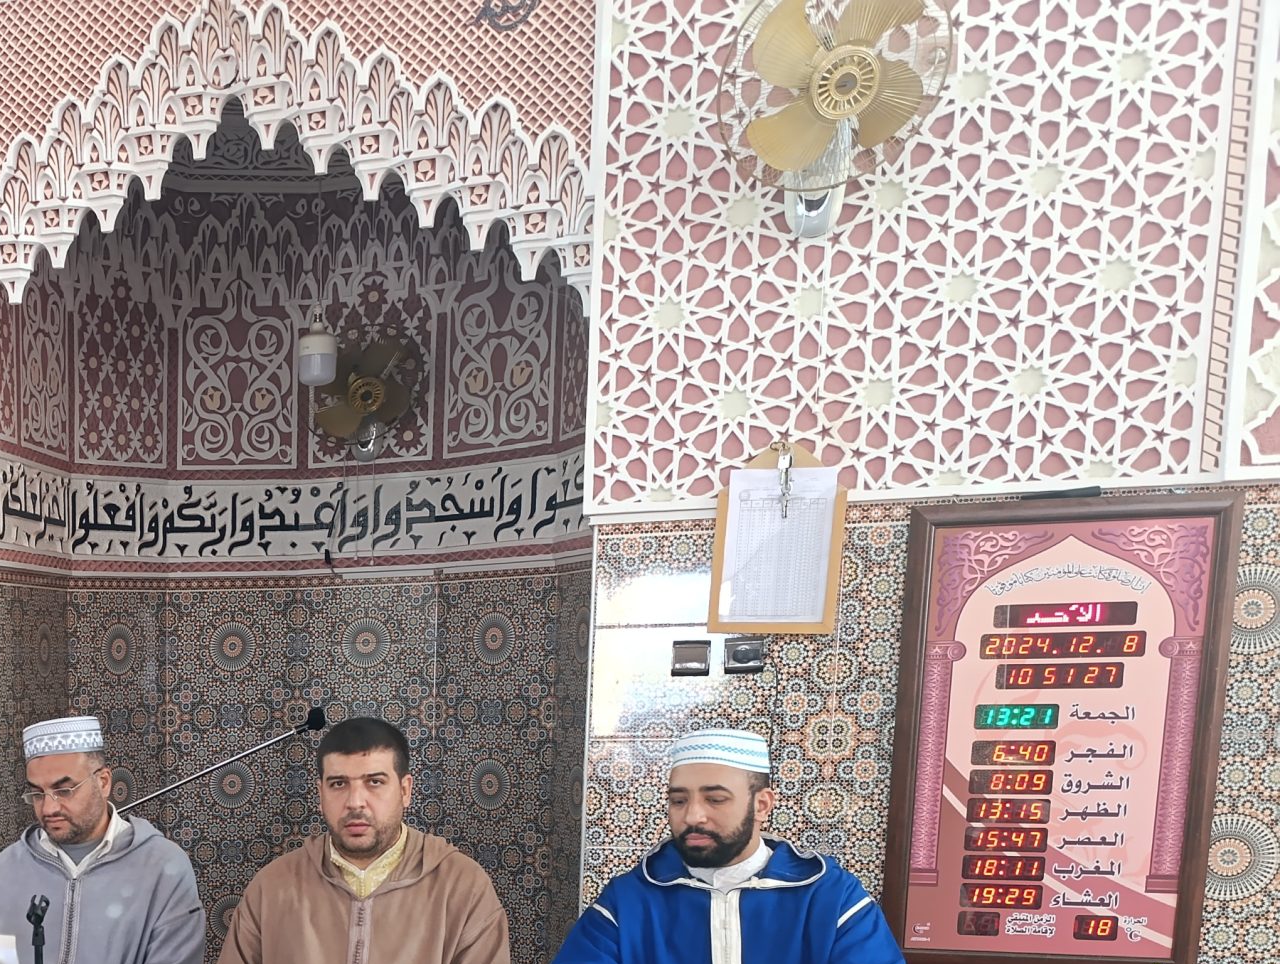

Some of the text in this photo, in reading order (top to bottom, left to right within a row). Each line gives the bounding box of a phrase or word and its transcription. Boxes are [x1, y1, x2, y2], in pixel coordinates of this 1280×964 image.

[985, 707, 1053, 726] 13:21
[1069, 703, 1136, 725] الجمعة
[992, 744, 1049, 762] 6:40
[1064, 742, 1134, 764] الفجر
[990, 773, 1047, 791] 8:09
[1060, 771, 1130, 794] الشروق
[979, 802, 1043, 820] 13:15
[1059, 801, 1127, 821] الظهر
[976, 831, 1042, 848] 15:47
[1056, 832, 1124, 850] العصر
[974, 859, 1039, 876] 18:11
[1053, 860, 1121, 879] المغرب
[972, 887, 1036, 905] 19:29
[1050, 889, 1119, 908] العشاء
[1088, 919, 1112, 936] 18
